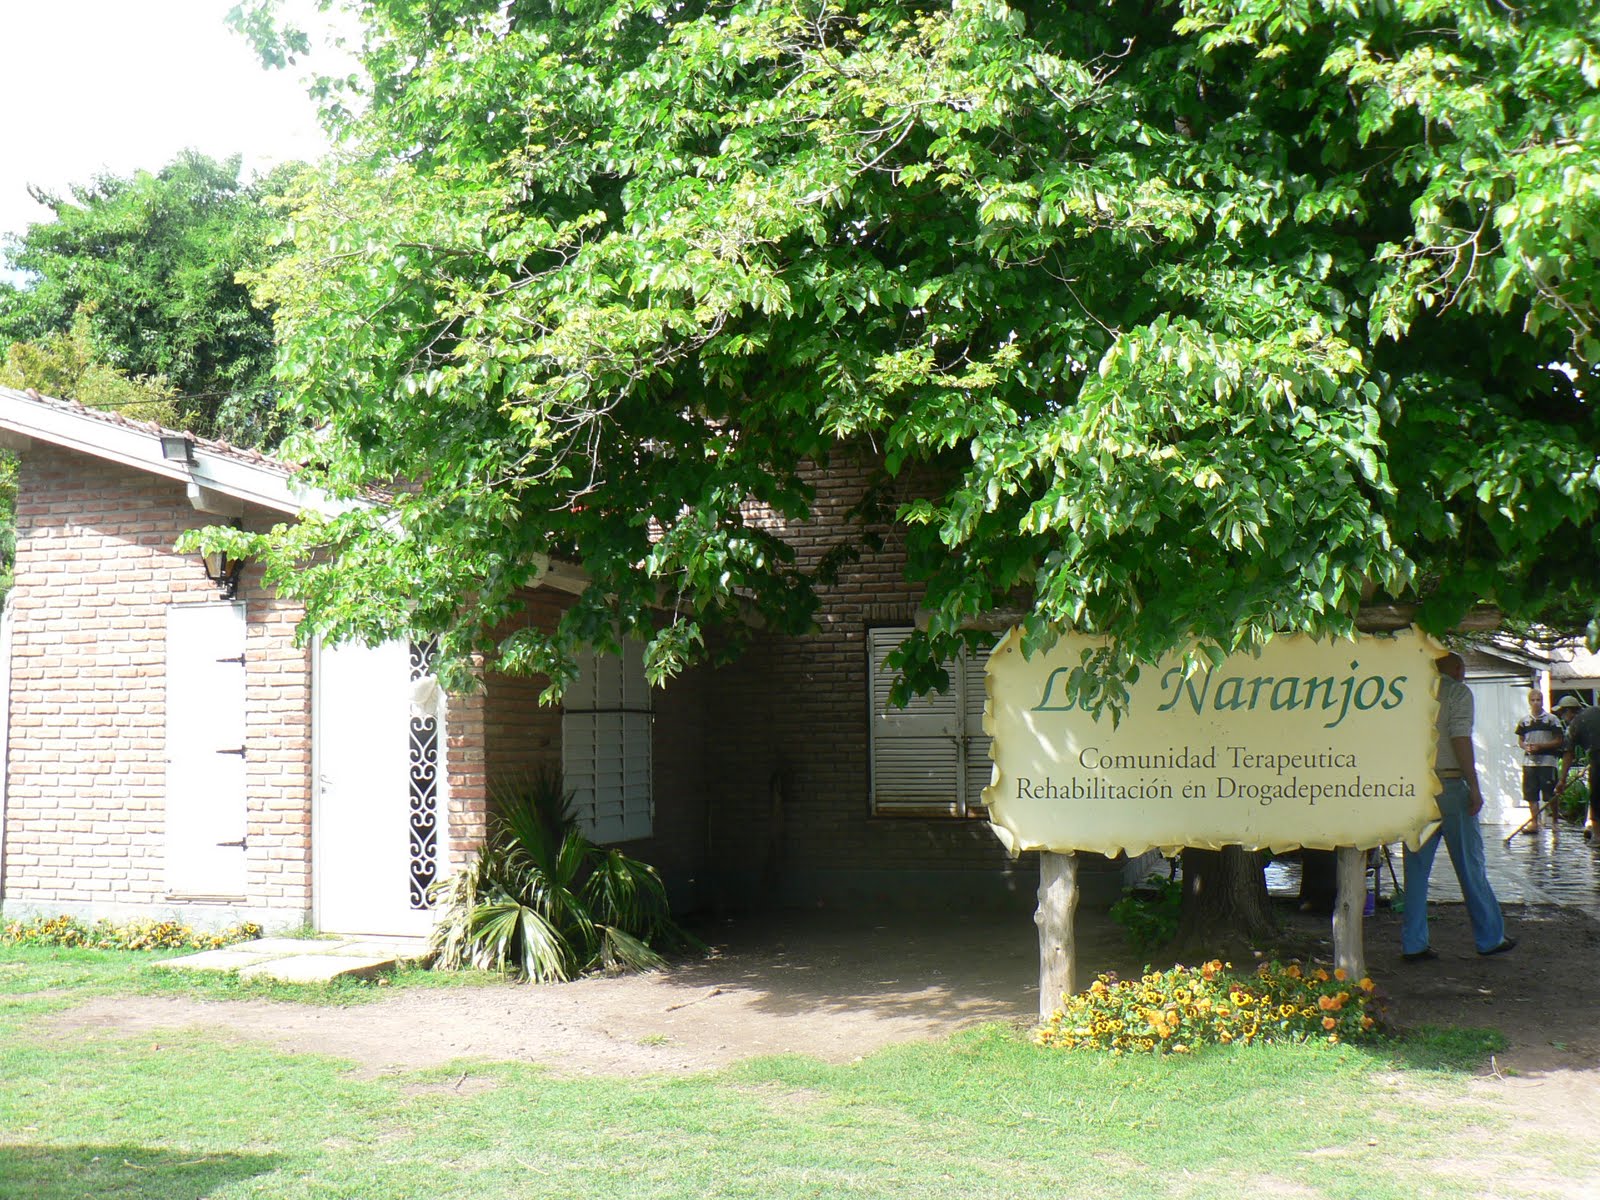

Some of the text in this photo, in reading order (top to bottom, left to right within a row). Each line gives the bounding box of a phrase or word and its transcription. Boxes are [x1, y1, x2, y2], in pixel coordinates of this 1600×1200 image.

[1157, 660, 1408, 728] Naranjos
[1079, 746, 1357, 776] Comunidad Terapeutica
[1015, 777, 1173, 799] Rehabilitación
[1216, 776, 1416, 805] Drogadependencia
